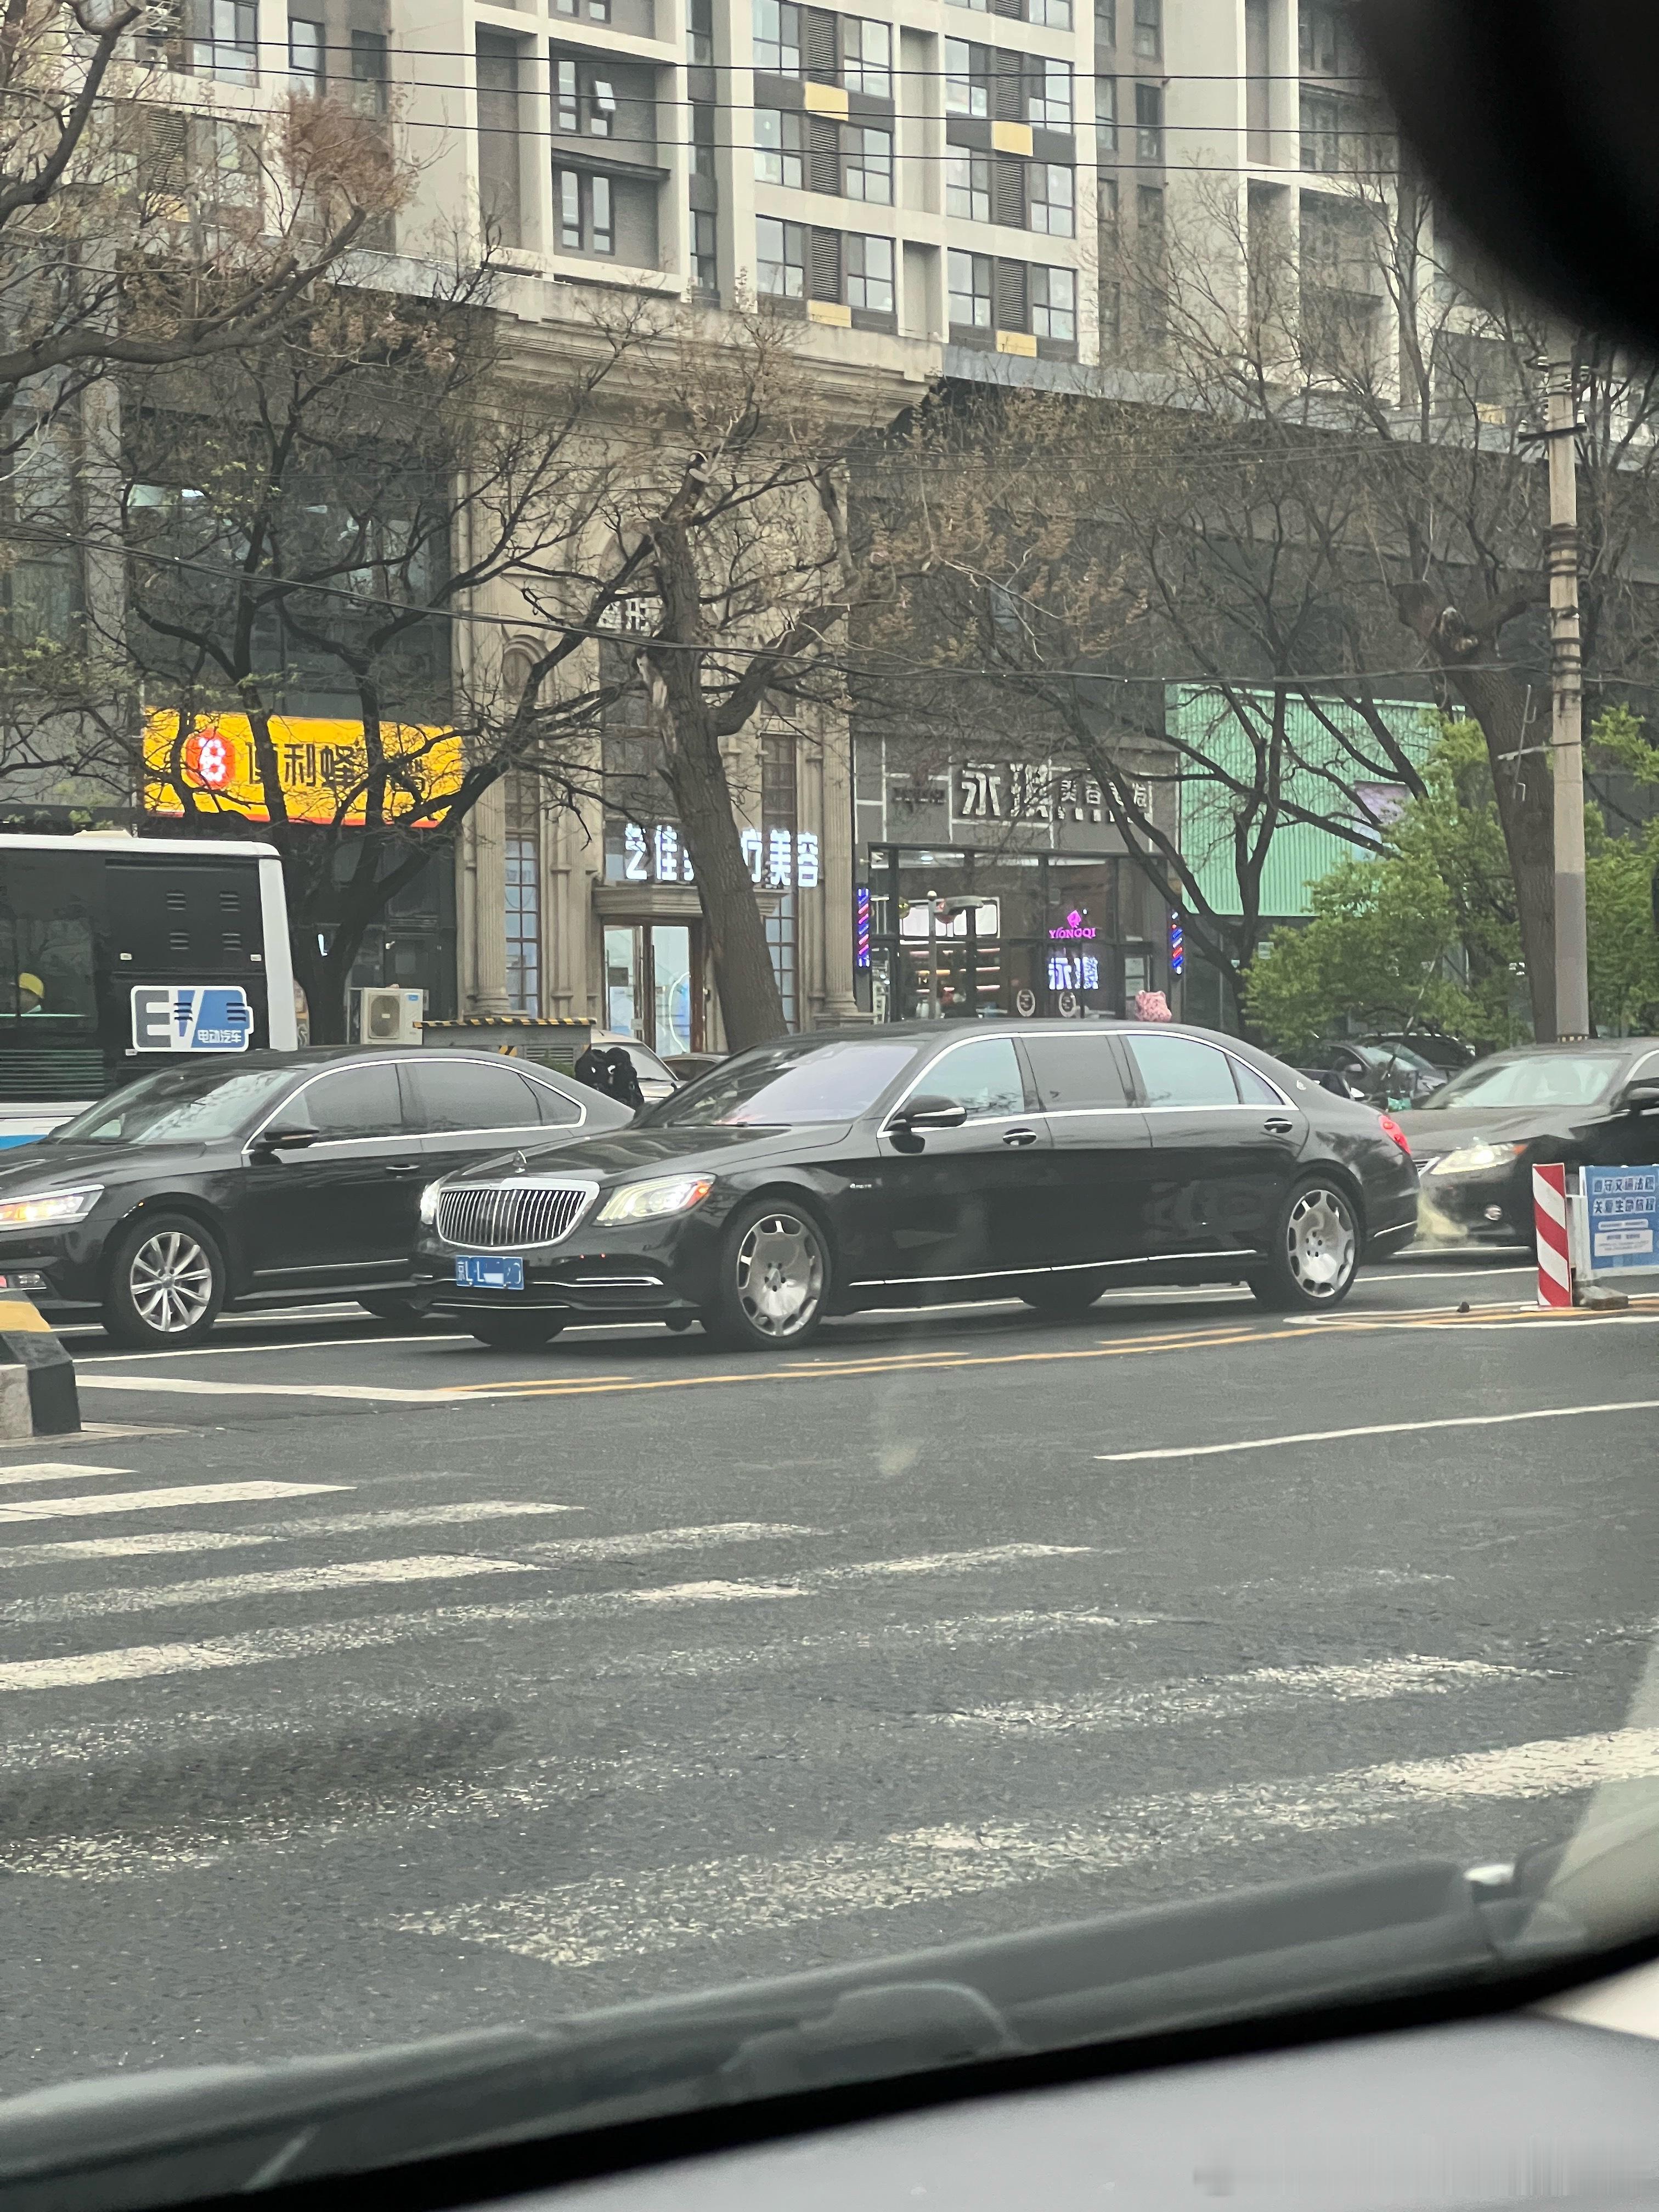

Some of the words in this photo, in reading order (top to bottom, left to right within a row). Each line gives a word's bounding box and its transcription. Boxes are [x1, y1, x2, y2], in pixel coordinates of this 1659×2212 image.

[1049, 927, 1096, 939] YONGQI
[135, 990, 204, 1047] EV
[198, 1030, 242, 1043] 电动汽车
